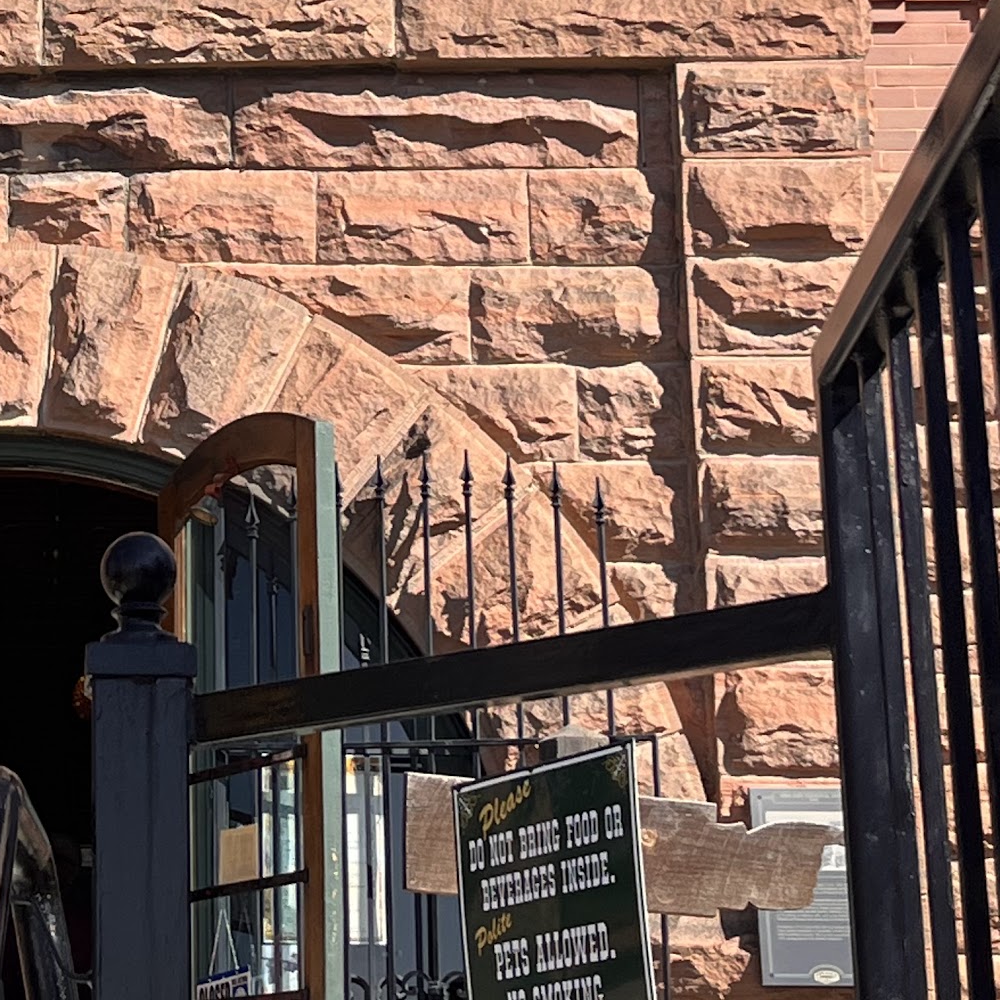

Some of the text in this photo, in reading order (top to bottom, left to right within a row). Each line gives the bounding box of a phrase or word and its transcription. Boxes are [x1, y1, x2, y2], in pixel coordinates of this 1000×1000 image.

[468, 804, 624, 872] DO NOT BRING FOOD OR
[479, 779, 531, 841] Please
[480, 851, 616, 911] BEVERAGES INSIDE.
[474, 912, 513, 956] Polite
[493, 922, 617, 981] PETS ALLOWED.
